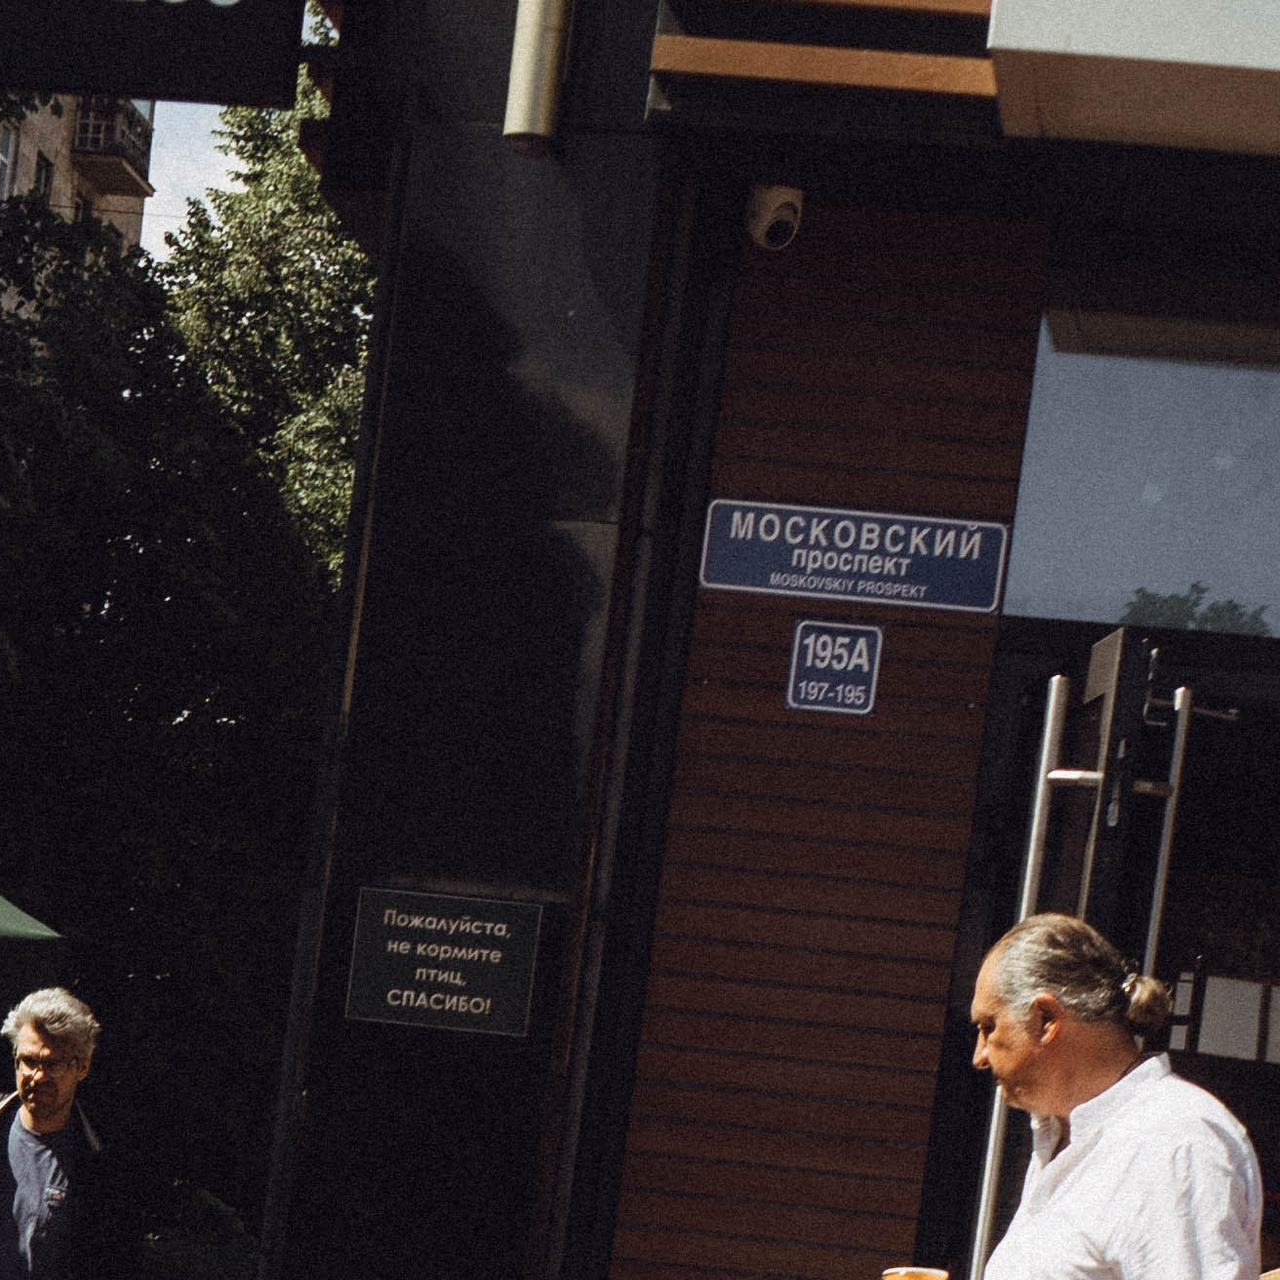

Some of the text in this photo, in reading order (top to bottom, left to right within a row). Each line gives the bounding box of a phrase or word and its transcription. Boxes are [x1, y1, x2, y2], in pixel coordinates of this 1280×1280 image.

[729, 511, 983, 560] МОСКОВСКИЙ
[791, 547, 912, 577] проспект
[770, 572, 927, 598] MOSKOVSKIY PROSPEKT
[803, 632, 870, 673] 195А
[798, 680, 867, 704] 197-195
[383, 909, 512, 938] Пожалуйста,
[387, 939, 502, 963] не кормите
[386, 989, 492, 1015] СПАСИБО!
